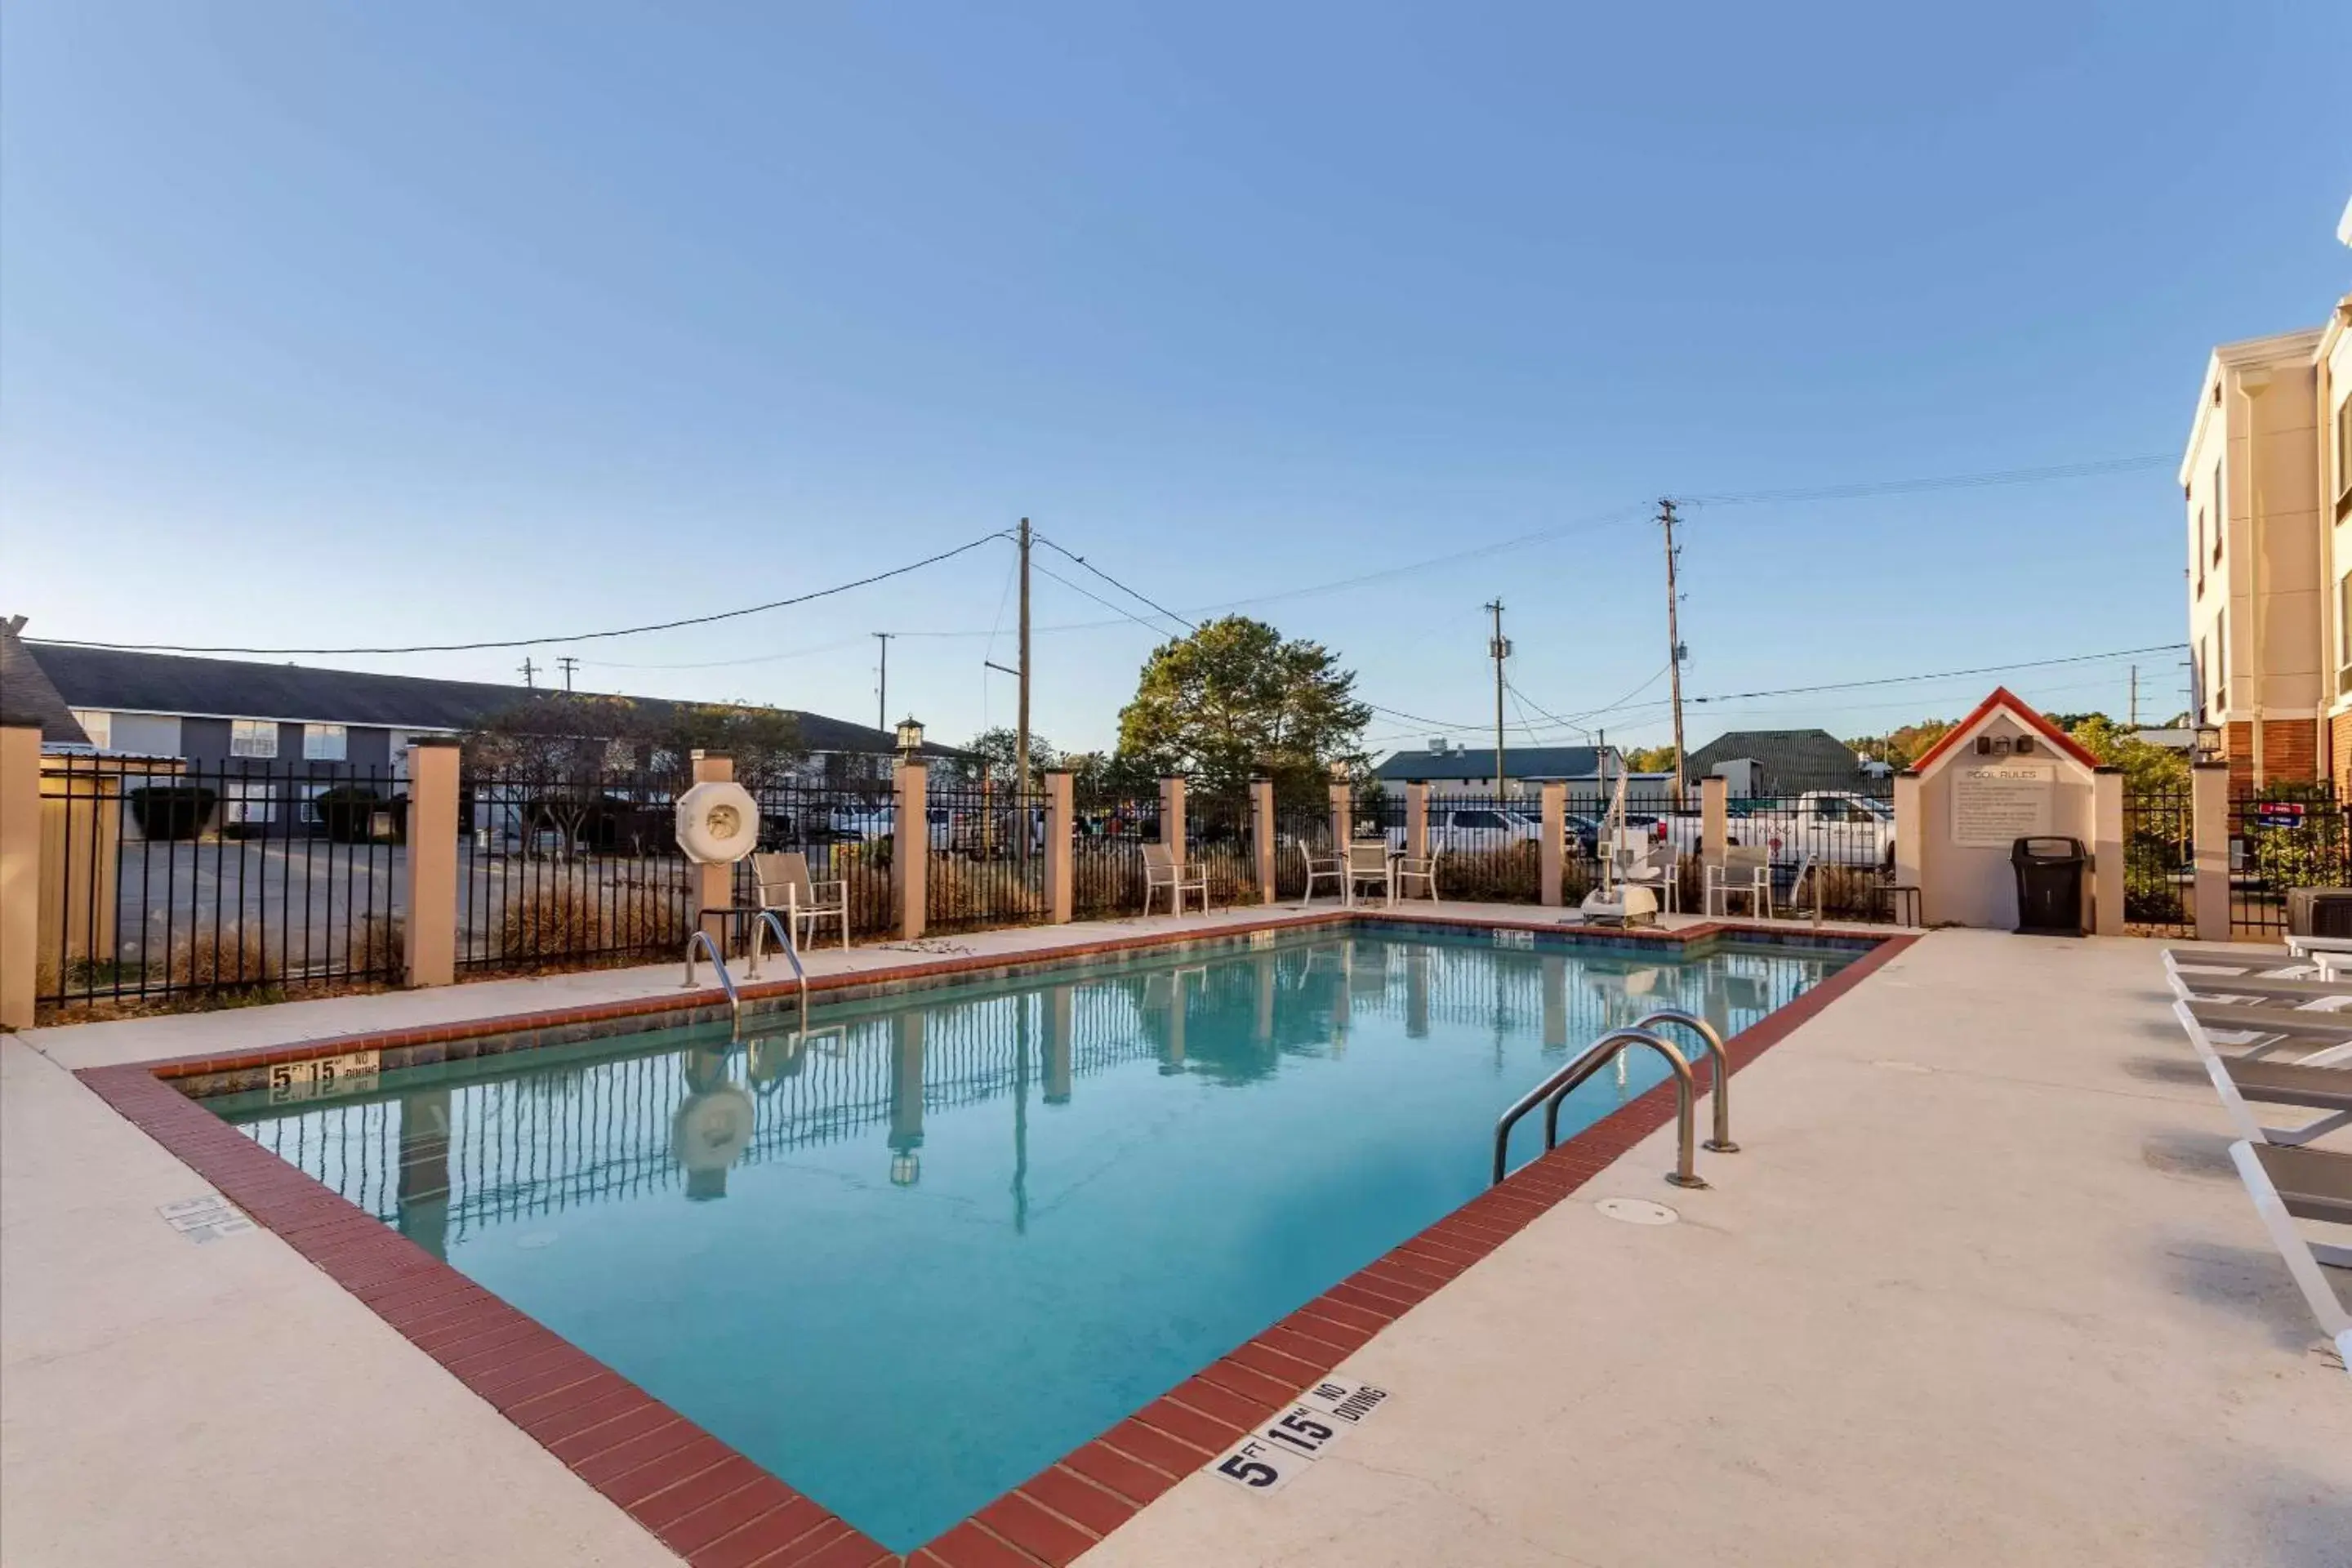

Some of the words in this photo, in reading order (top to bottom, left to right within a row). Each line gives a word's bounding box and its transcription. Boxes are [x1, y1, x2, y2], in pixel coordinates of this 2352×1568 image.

[2000, 770, 2037, 779] RULES
[355, 1051, 368, 1065] NO
[1313, 1383, 1347, 1401] NO
[1332, 1387, 1388, 1422] DIVING
